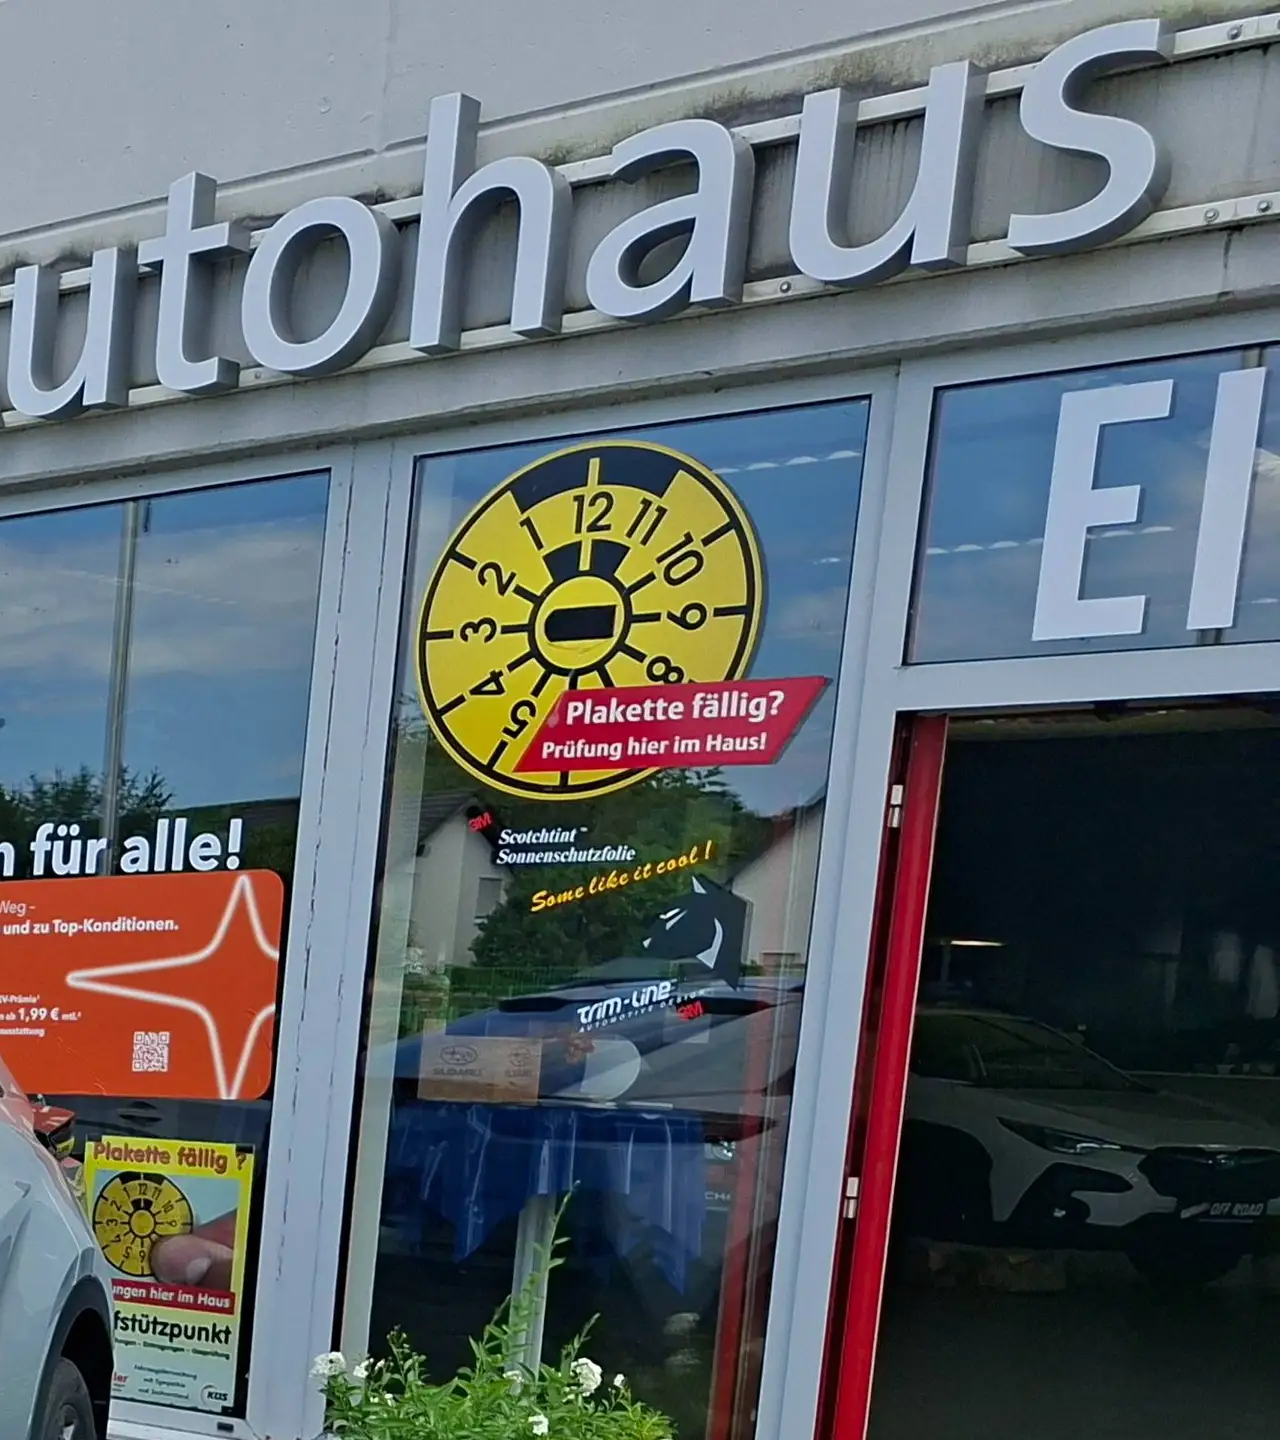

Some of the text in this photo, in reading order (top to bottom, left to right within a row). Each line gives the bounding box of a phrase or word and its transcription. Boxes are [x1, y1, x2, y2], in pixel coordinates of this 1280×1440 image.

[573, 491, 614, 534] 12
[625, 498, 669, 546] 11
[519, 517, 545, 550] 1
[656, 532, 705, 586] 10
[476, 561, 517, 596] 2
[459, 617, 497, 643] 3
[469, 669, 507, 699] 4
[502, 700, 536, 740] 5
[566, 690, 785, 726] Plakette fällig?
[542, 732, 767, 761] Prüfung hier im Haus!
[29, 823, 108, 875] für
[119, 817, 244, 872] alle!
[498, 827, 577, 845] Scotchtint
[495, 845, 636, 865] Sonnenschutzfolie
[530, 884, 585, 912] Some
[588, 871, 629, 894] like
[633, 864, 652, 880] it
[656, 849, 698, 873] cool
[3, 917, 30, 935] und
[33, 919, 50, 934] zu
[52, 915, 180, 936] Top-Konditionen.
[18, 1008, 48, 1022] 1,99
[50, 1008, 61, 1021] €
[93, 1142, 248, 1174] Plakette fällig ?
[112, 1285, 232, 1309] ungen hier im Haus
[113, 1310, 232, 1345] fstützpunkt
